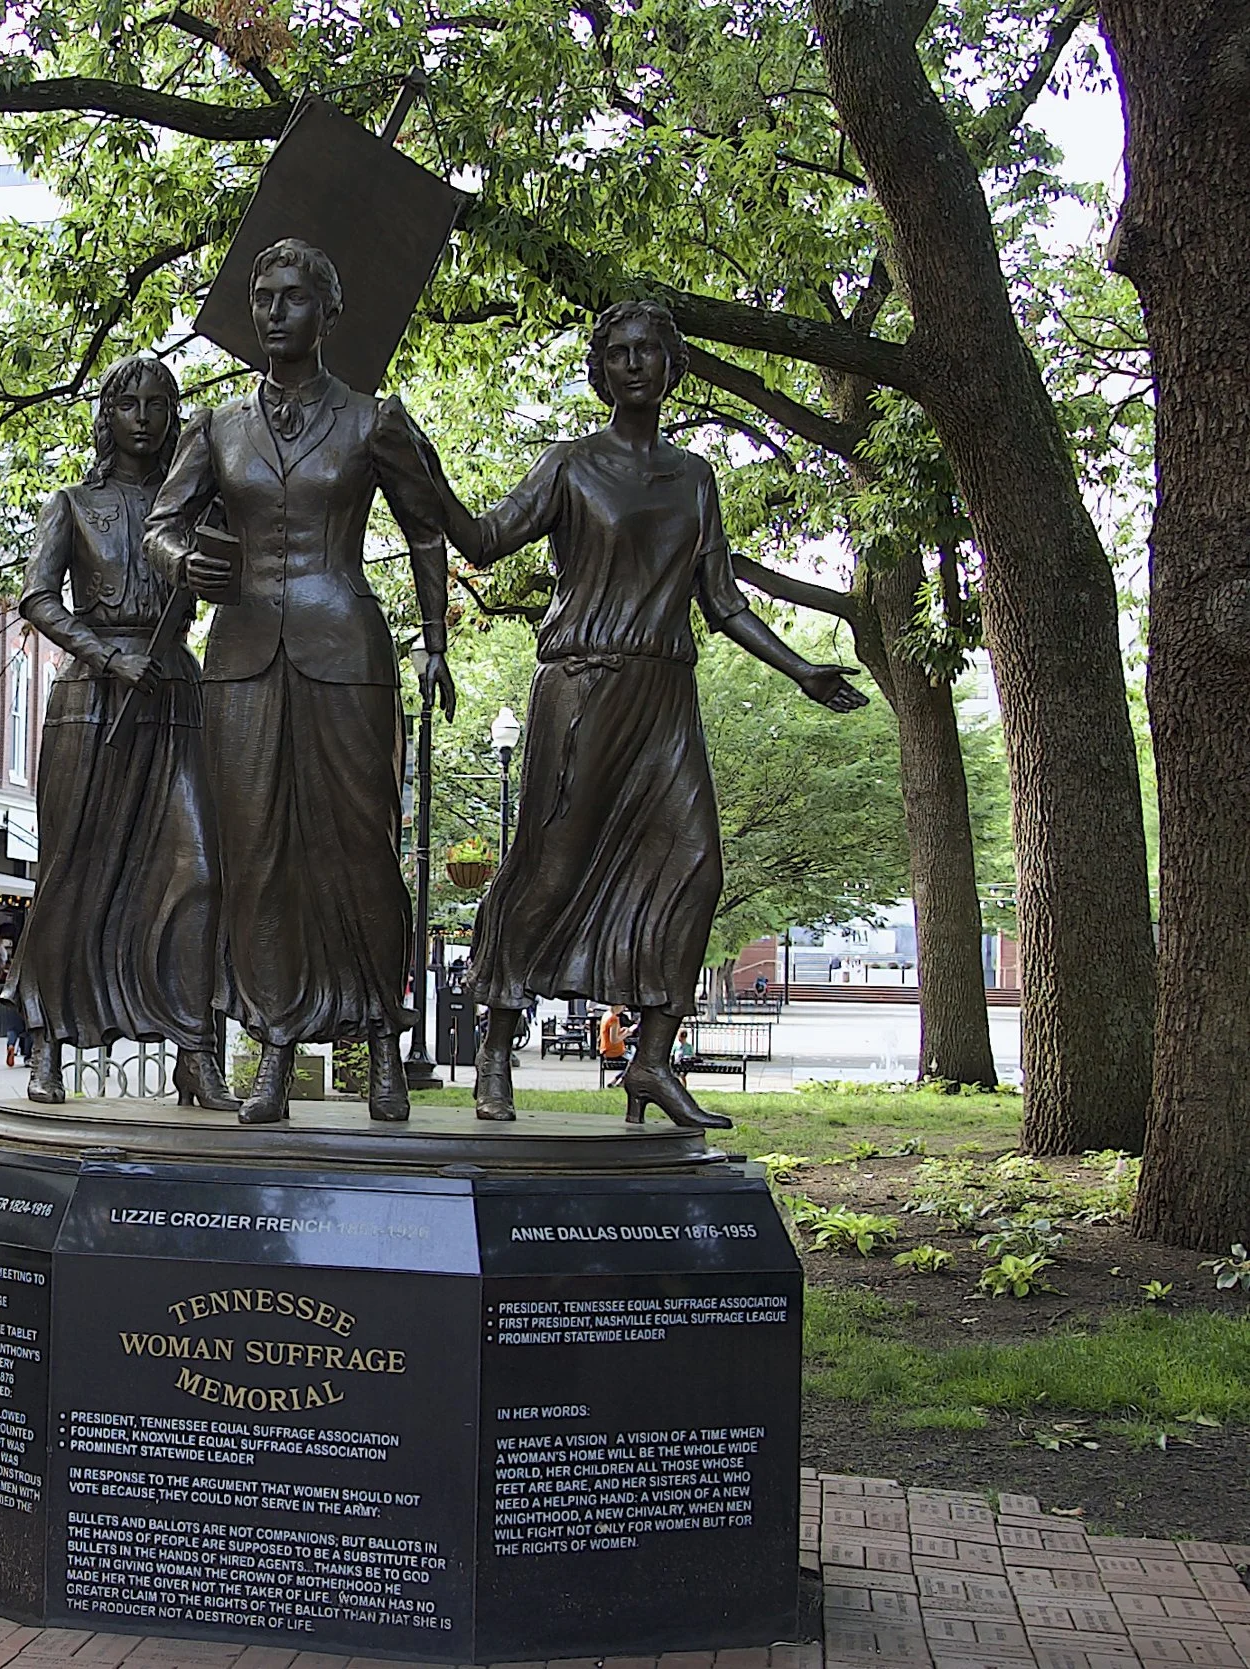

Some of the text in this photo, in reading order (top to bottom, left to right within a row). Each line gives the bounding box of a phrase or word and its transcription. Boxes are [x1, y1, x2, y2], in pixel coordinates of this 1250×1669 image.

[8, 1200, 54, 1217] 1824-1916
[111, 1208, 167, 1226] LIZZIE
[170, 1212, 252, 1230] CROZIER
[255, 1216, 332, 1234] FRENCH
[511, 1223, 757, 1242] ANNE DALLAS DUDLEY 1876-1955
[167, 1288, 357, 1338] TENNESSEE
[498, 1296, 787, 1315] PRESIDENT, TENNESSEE EQUAL SUFFRAGE ASSOCIATION
[498, 1310, 786, 1329] FIRST PRESIDENT, NASHVILLE EQUAL SUFFRAGE LEAGUE
[498, 1328, 665, 1344] PROMINENT STATEWIDE LEADER
[118, 1331, 407, 1374] WOMAN SUFFRAGE
[174, 1366, 346, 1412] MEMORIAL
[496, 1404, 590, 1419] IN HER WORDS:
[70, 1411, 399, 1446] PRESIDENT, TENNESSEE EQUAL SUFFRAGE ASSOCIATION
[496, 1426, 764, 1449] WE HAVE A VISION A VISION OF A TIME WHEN
[69, 1439, 254, 1464] PROMINENT STATEWIDE LEADER
[70, 1425, 386, 1460] FOUNDER, KNOXVILLE EQUAL SUFFRAGE ASSOCIATION
[495, 1441, 757, 1464] A WOMAN'S HOME WILL BE THE WHOLE WIDE
[495, 1456, 744, 1480] WORLD, HER CHILDREN ALL THOSE WHOSE
[69, 1467, 420, 1505] IN RESPONSE TO THE ARGUMENT THAT WOMEN SHOULD NOT
[495, 1470, 751, 1495] FEET ARE BARE, AND HER SISTERS ALL WHO
[68, 1481, 99, 1494] VOTE
[157, 1488, 188, 1501] THEY
[190, 1490, 232, 1505] COULD
[233, 1494, 259, 1507] NOT
[260, 1496, 300, 1510] SERVE
[301, 1499, 314, 1511] IN
[316, 1501, 341, 1514] THE
[343, 1503, 380, 1517] ARMY:
[68, 1511, 437, 1554] BULLETS AND BALLOTS ARE NOT COMPANIONS; BUT BALLOTS IN
[67, 1525, 446, 1569] THE HANDS OF PEOPLE ARE SUPPOSED TO BE A SUBSTITUTE FOR
